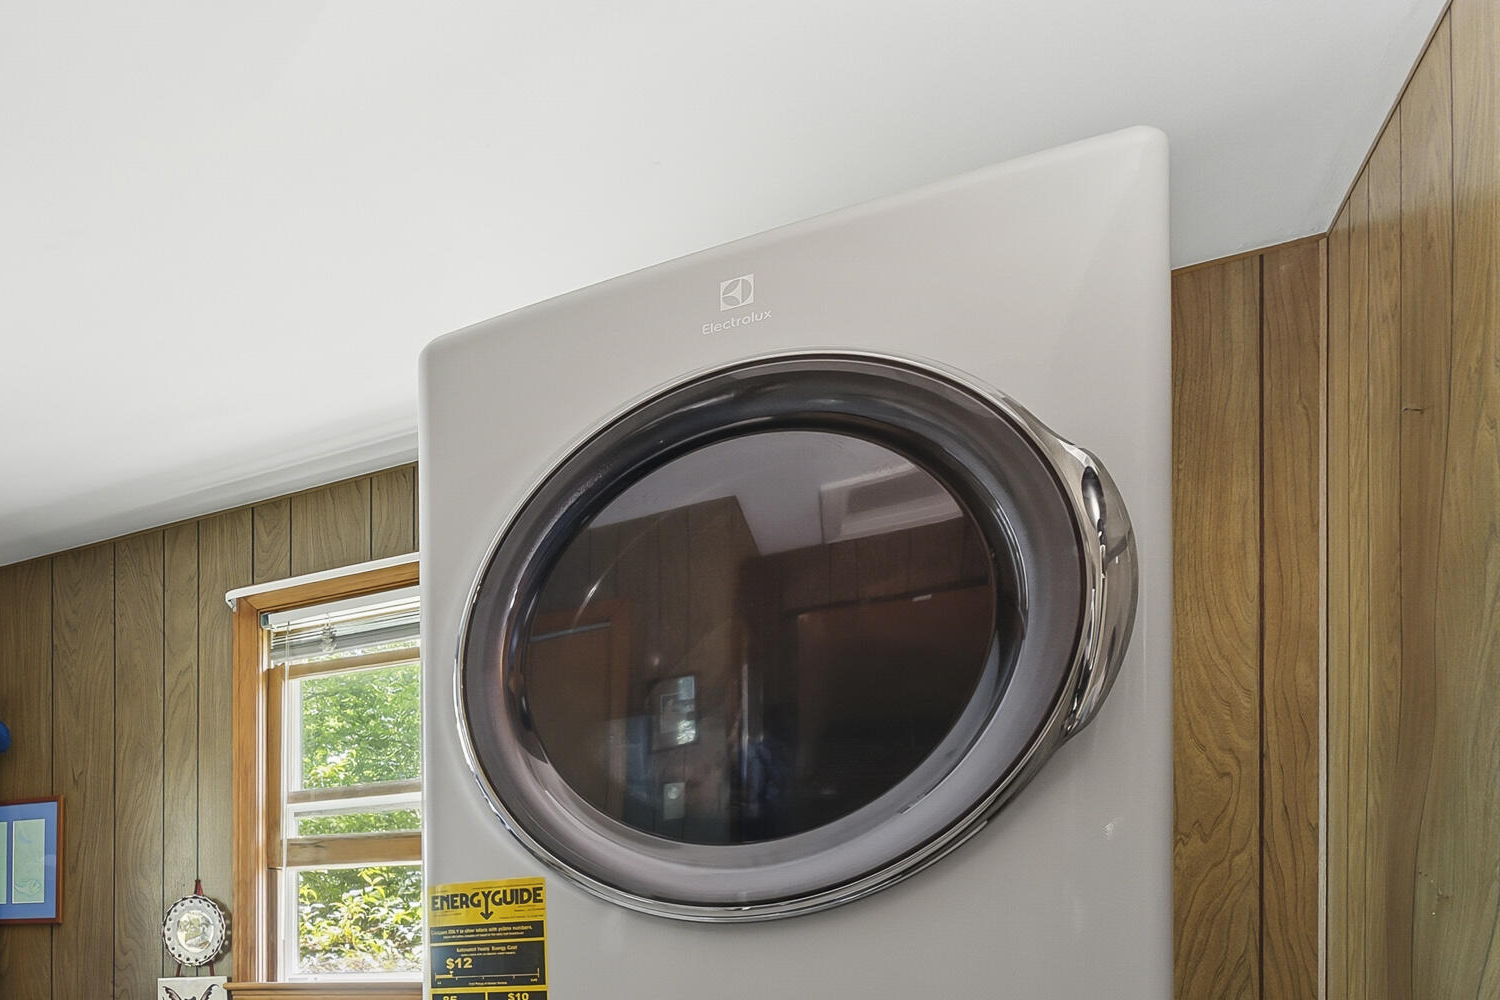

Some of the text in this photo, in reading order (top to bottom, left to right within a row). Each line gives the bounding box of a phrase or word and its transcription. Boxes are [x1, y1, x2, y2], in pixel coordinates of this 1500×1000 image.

[701, 310, 772, 335] Electrolux
[431, 886, 543, 912] ENERGYGUIDE
[446, 957, 472, 969] $12
